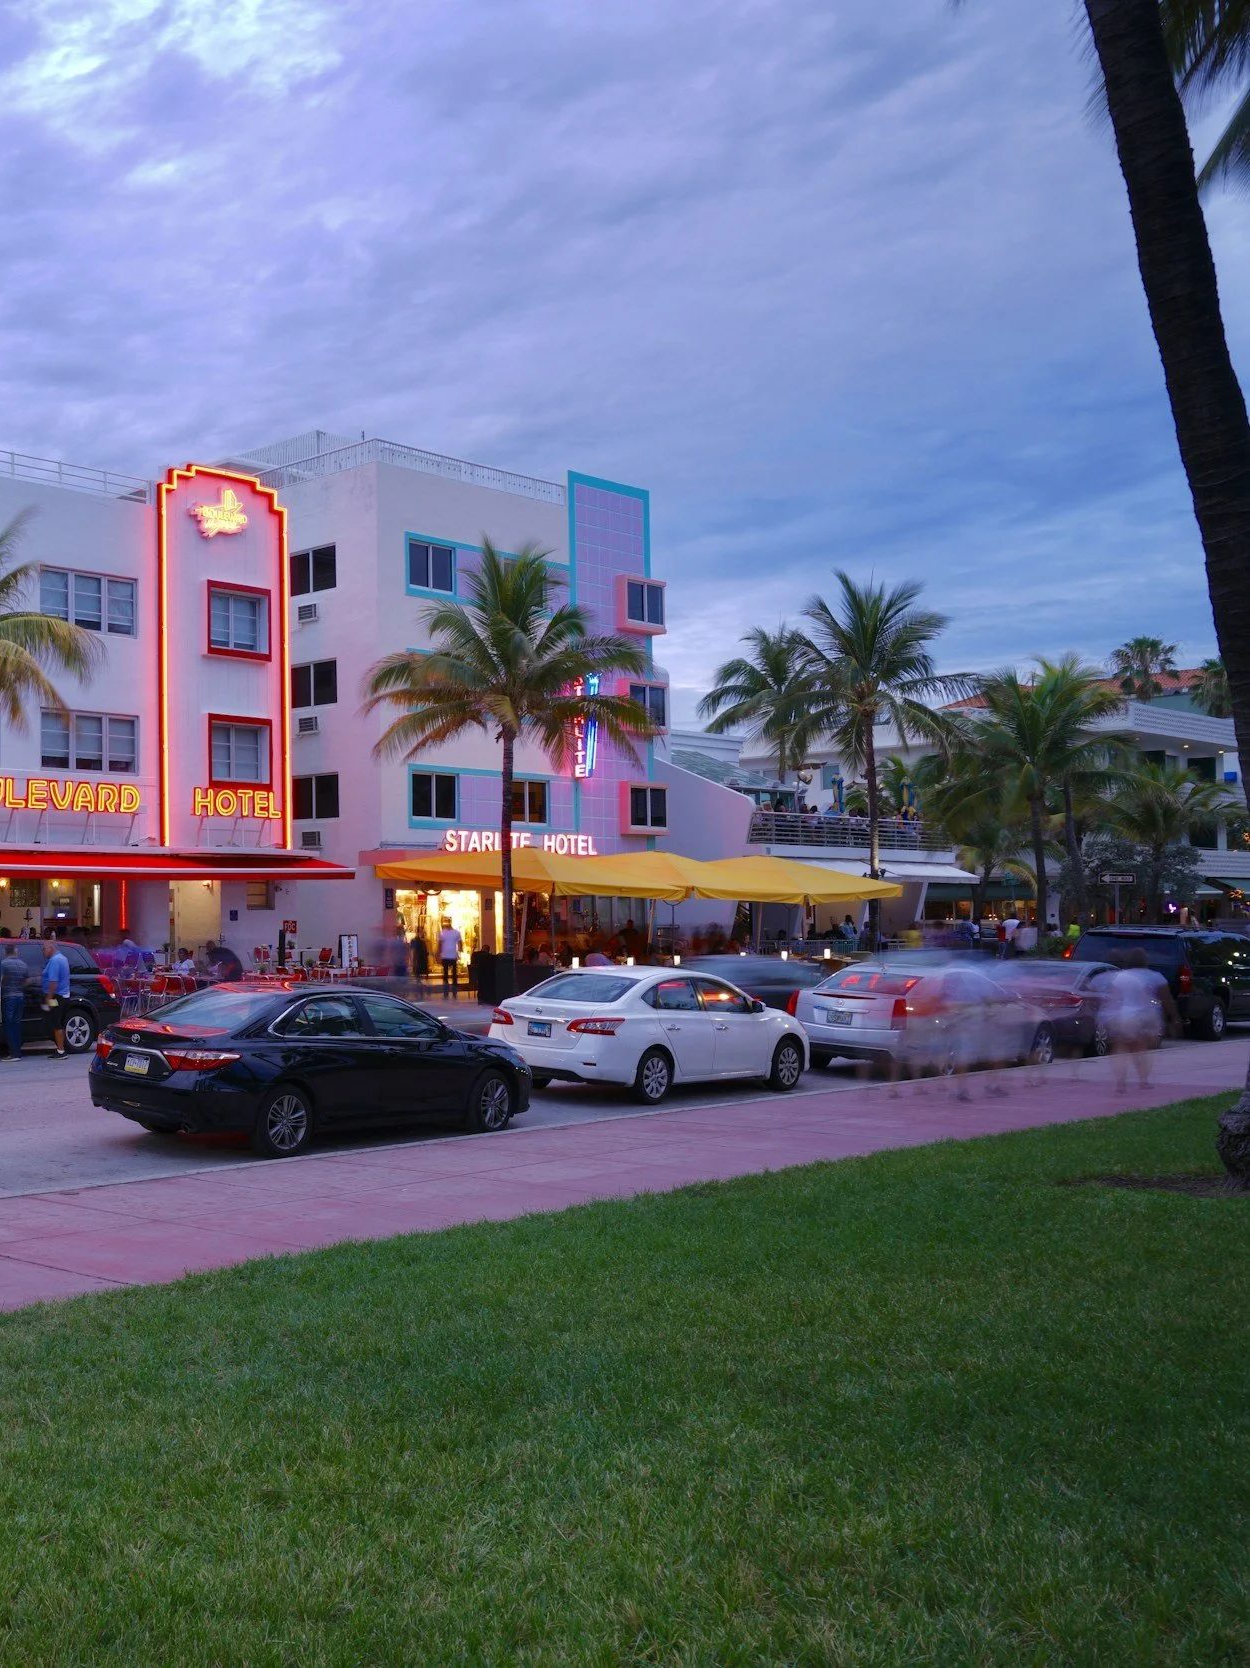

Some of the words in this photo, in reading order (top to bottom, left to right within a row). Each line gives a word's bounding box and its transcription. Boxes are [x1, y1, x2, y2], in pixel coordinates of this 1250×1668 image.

[193, 787, 283, 819] HOTEL
[445, 829, 532, 852] STARLTE
[543, 834, 598, 855] HOTEL
